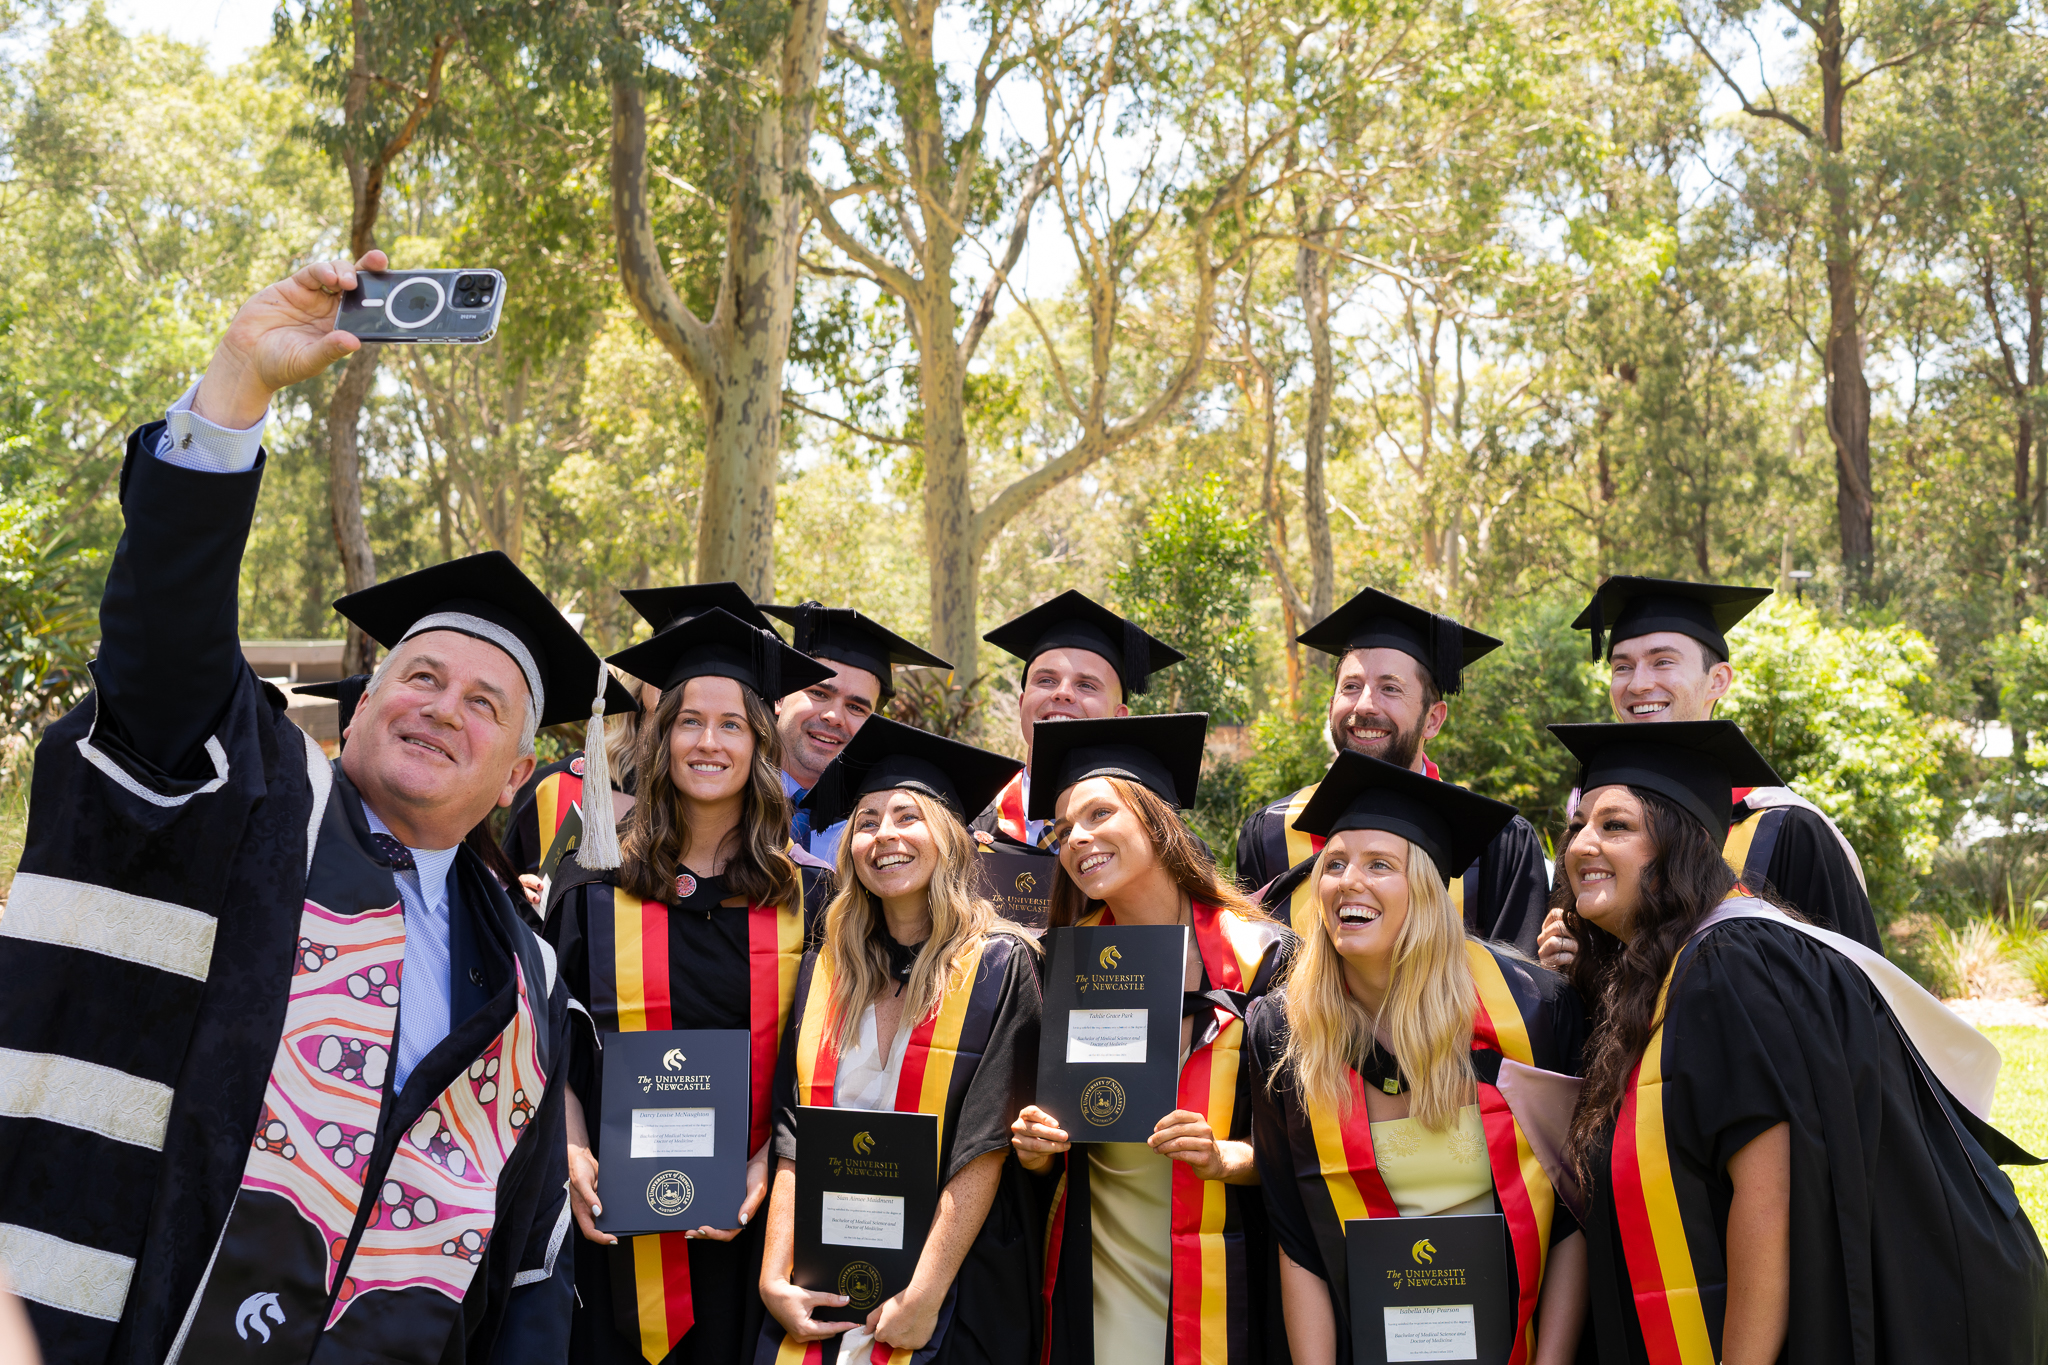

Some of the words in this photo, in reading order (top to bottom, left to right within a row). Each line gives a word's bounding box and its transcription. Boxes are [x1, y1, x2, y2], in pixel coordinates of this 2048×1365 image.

[1008, 896, 1052, 906] UNIVERSIT
[1075, 974, 1088, 983] The
[1080, 983, 1089, 993] of
[637, 1076, 651, 1084] The
[643, 1083, 653, 1093] of
[828, 1157, 842, 1166] The
[845, 1158, 900, 1170] UNIVERSITY
[834, 1166, 843, 1176] of
[846, 1167, 900, 1178] NEWCASTLE
[1386, 1270, 1401, 1279] The
[1406, 1268, 1465, 1278] UNIVERSITY
[1393, 1278, 1403, 1289] of
[1408, 1278, 1466, 1287] NEWCASTLE
